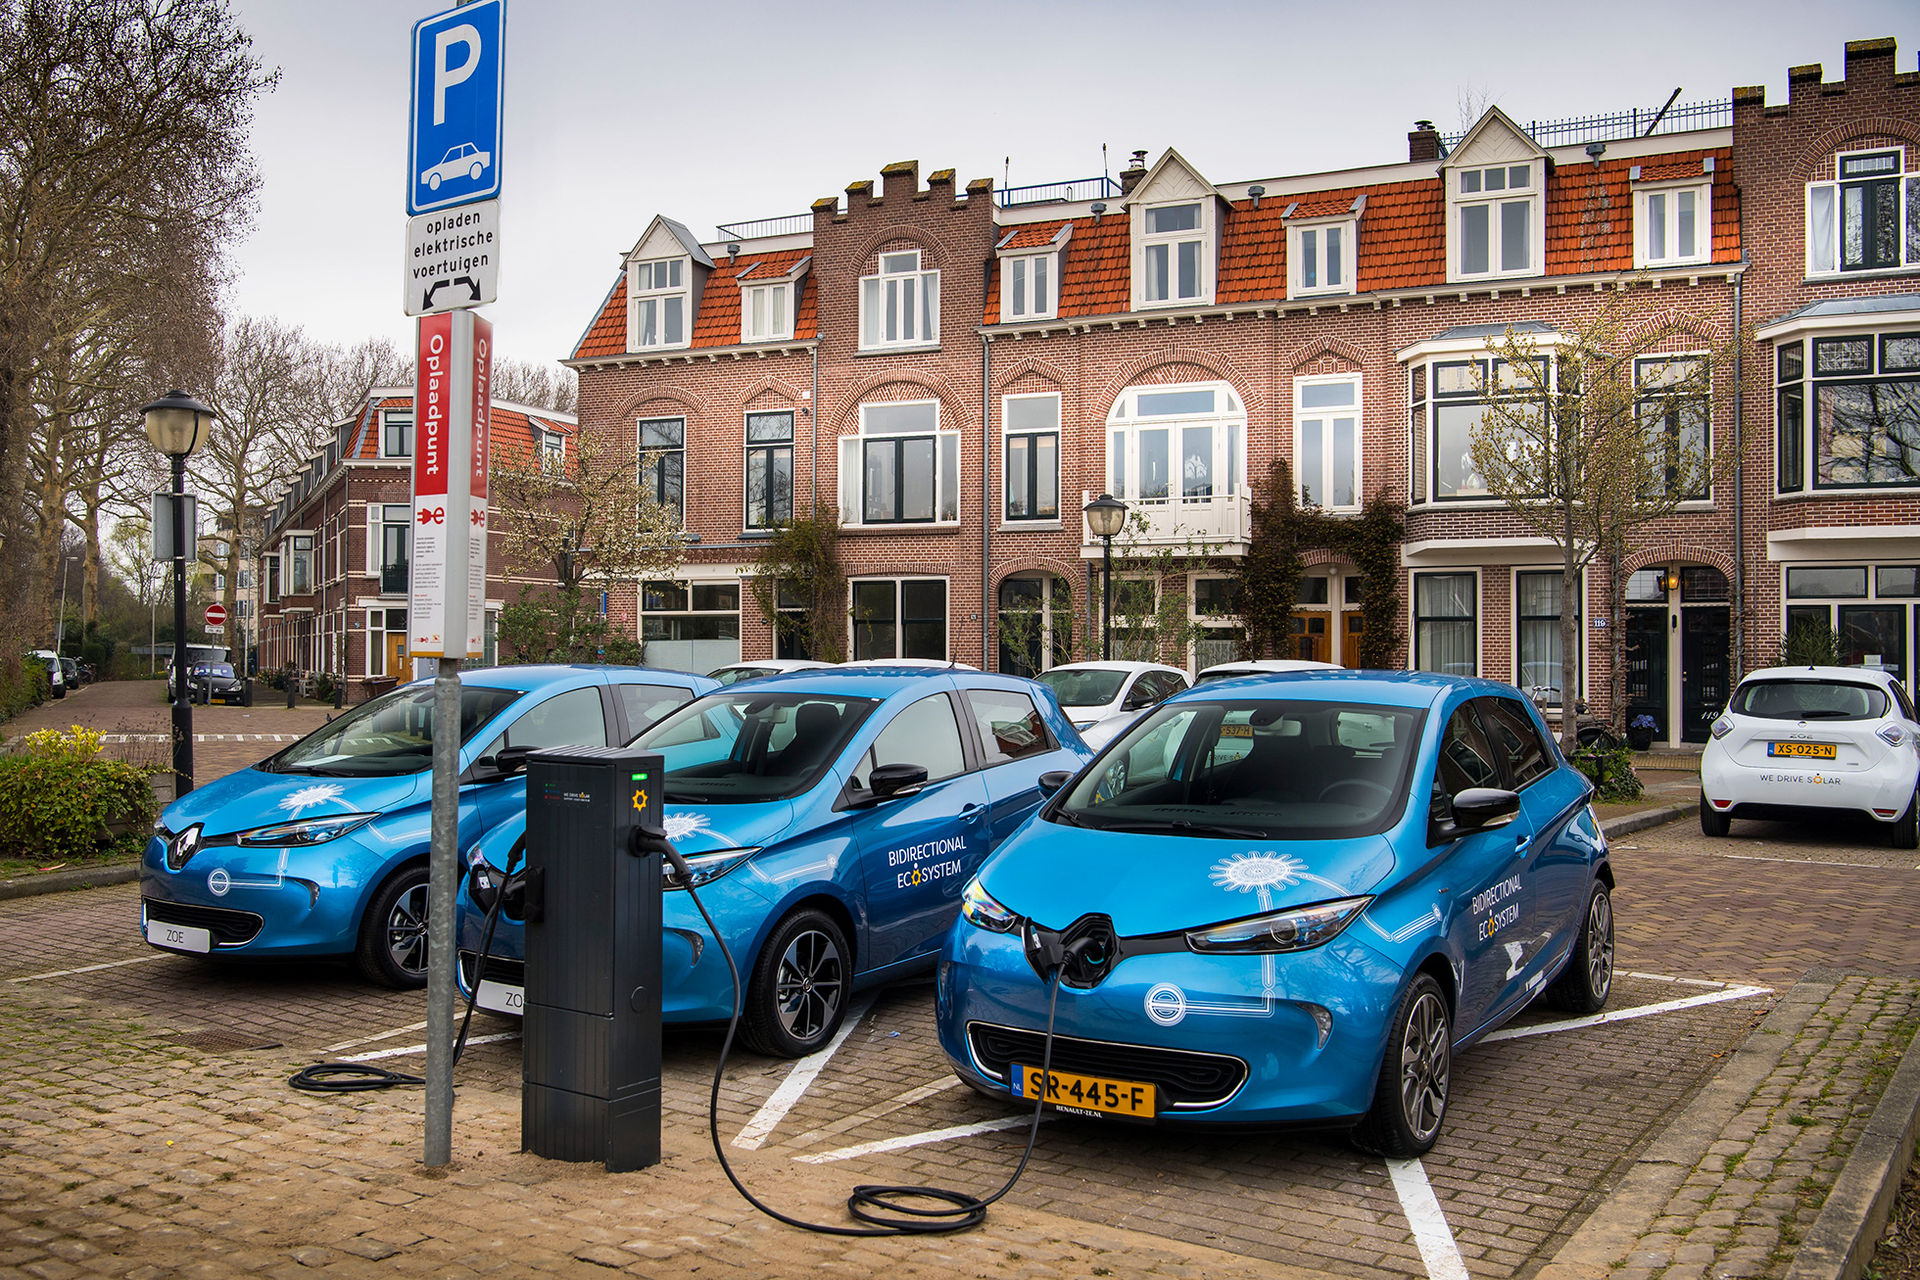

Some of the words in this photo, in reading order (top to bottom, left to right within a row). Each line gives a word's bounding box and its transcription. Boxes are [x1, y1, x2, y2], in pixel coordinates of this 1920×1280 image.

[433, 23, 482, 126] P
[426, 211, 481, 235] opladen
[413, 229, 494, 258] elektrische
[412, 253, 489, 279] voertuigen
[426, 334, 444, 476] Oplaadpunt
[475, 338, 487, 478] Oplaadpunt
[1701, 711, 1720, 720] 119
[1778, 744, 1832, 756] XS-025-N
[1759, 774, 1774, 782] WE
[1777, 774, 1804, 783] DRIVE
[1807, 773, 1841, 785] SOLAR
[888, 835, 967, 867] BIDIRECTIONAL
[897, 859, 962, 889] ECOSYSTEM
[1472, 873, 1522, 915] BIDIRECTIONAL
[166, 929, 184, 944] ZOE
[1479, 902, 1520, 942] ECOSYSTEM
[505, 991, 524, 1008] ZO
[1013, 1082, 1022, 1091] NL
[1030, 1071, 1144, 1111] SR-445-F
